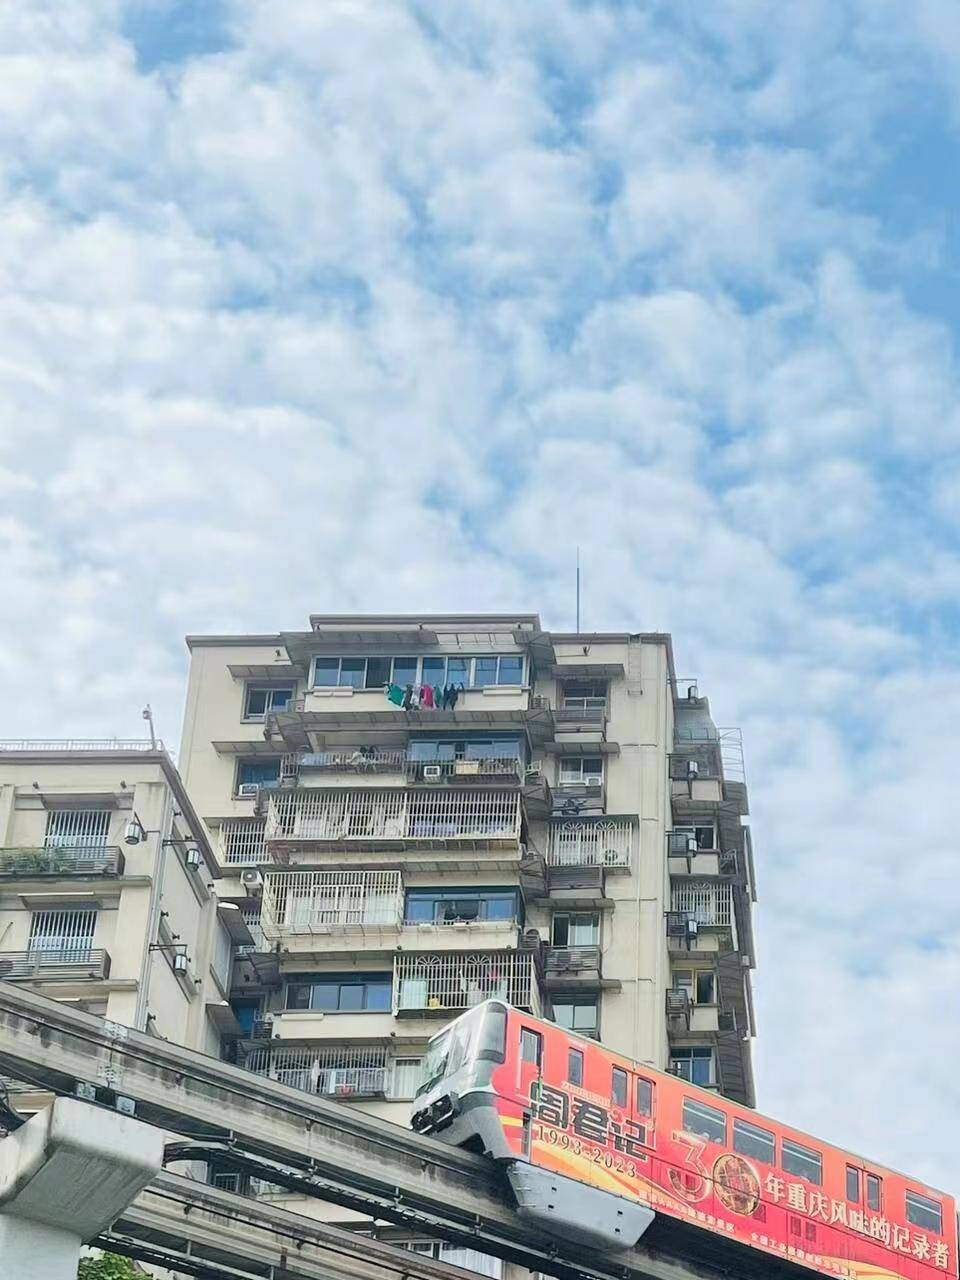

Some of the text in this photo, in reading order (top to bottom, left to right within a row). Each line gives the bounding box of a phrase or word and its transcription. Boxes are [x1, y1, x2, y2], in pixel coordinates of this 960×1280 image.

[530, 1081, 653, 1161] 周君记
[537, 1125, 637, 1179] 1993-2023
